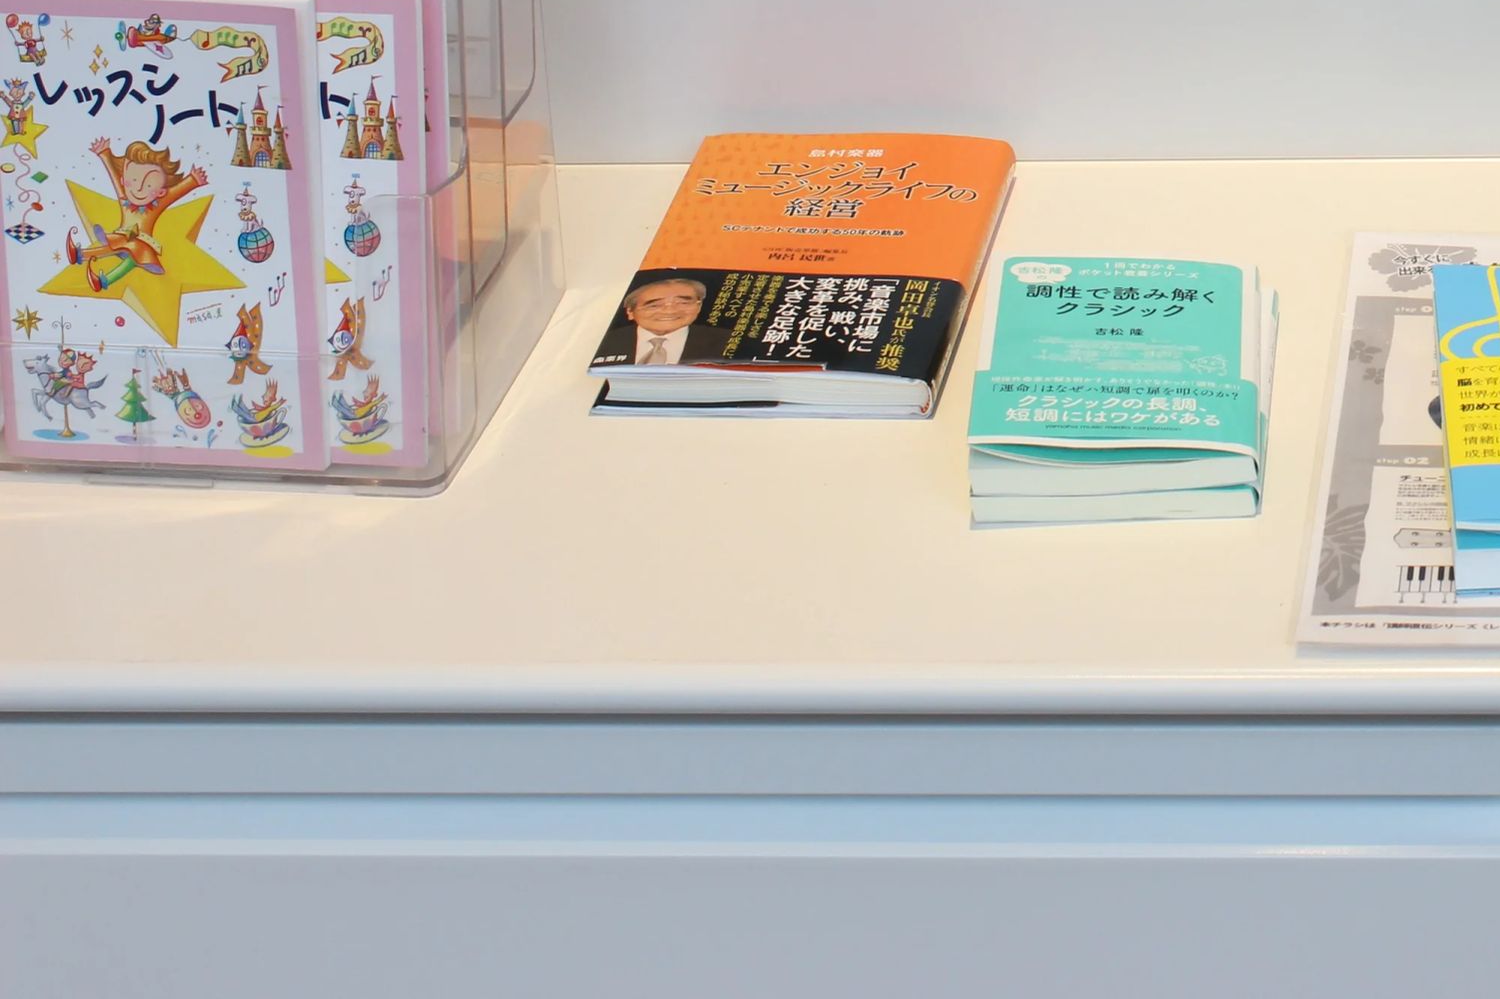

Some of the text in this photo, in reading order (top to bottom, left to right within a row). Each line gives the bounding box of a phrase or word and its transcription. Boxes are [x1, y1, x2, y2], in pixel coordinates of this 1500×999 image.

[33, 62, 179, 117] レッスン
[148, 89, 239, 145] ノート
[758, 161, 919, 181] エンジョイ
[694, 178, 978, 203] ミュージックライフの
[783, 197, 864, 219] 経営
[1026, 284, 1216, 304] 調性で読み解く
[786, 277, 842, 359] 変革を促した
[825, 277, 870, 345] 挑み、戦い、
[849, 278, 901, 353] 「音楽市場に
[1056, 302, 1186, 318] クラシック
[875, 279, 929, 371] 岡田卓也氏が推奨
[1017, 395, 1208, 412] クラシックの長調、
[1005, 407, 1222, 427] 短調にはワケがある
[1403, 456, 1430, 465] 02
